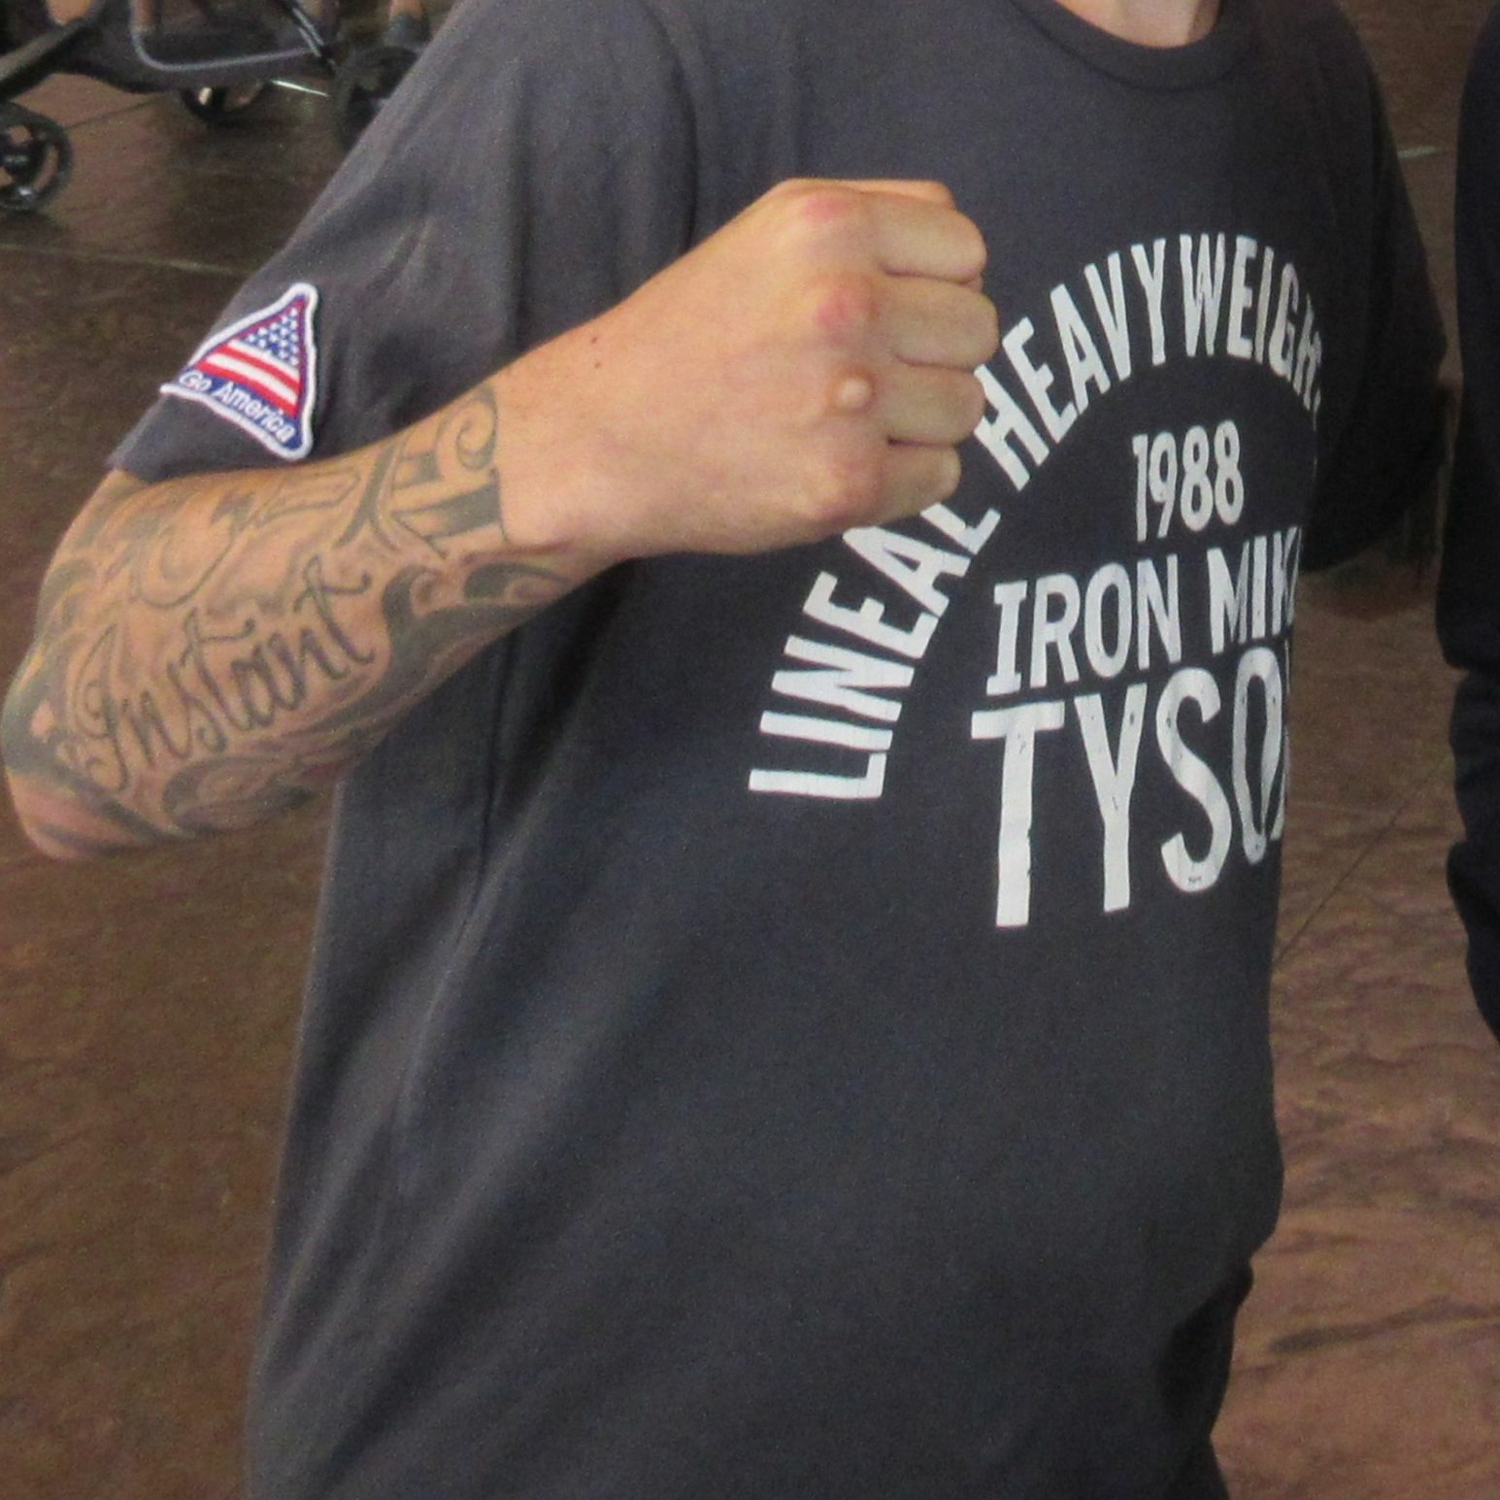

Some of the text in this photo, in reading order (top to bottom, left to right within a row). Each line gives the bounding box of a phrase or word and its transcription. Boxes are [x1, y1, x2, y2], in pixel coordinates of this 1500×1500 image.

[179, 371, 296, 443] Go America
[1132, 420, 1245, 541] 1988
[748, 502, 1000, 799] LINEAL
[986, 526, 1301, 695] IRON MIK
[971, 640, 1291, 927] TYSO
